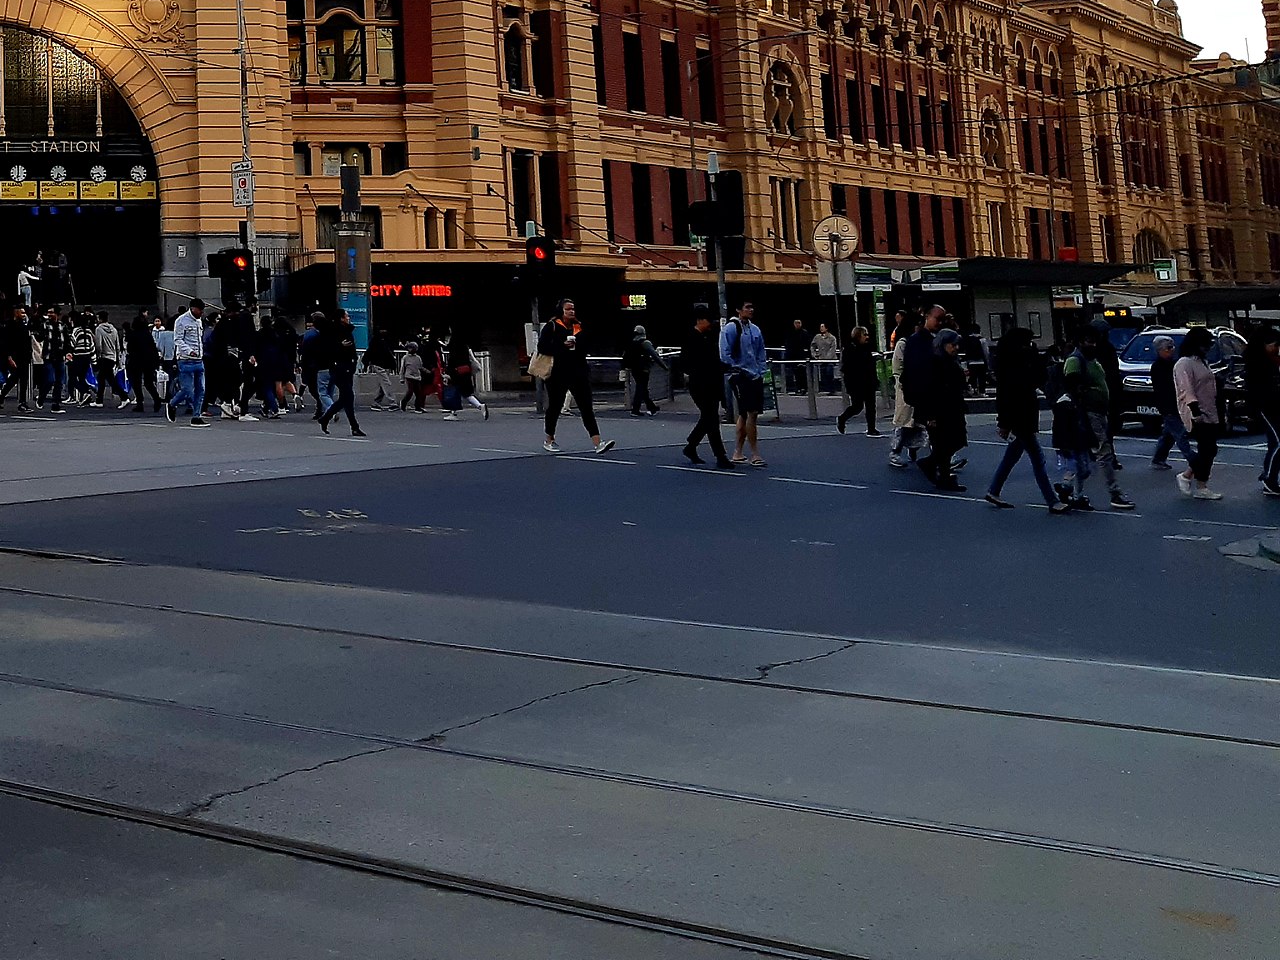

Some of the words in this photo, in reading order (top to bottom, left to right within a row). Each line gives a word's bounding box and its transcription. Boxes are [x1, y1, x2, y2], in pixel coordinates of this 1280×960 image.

[30, 140, 101, 154] STATION
[370, 285, 402, 296] CITY
[412, 285, 452, 296] HATTERS
